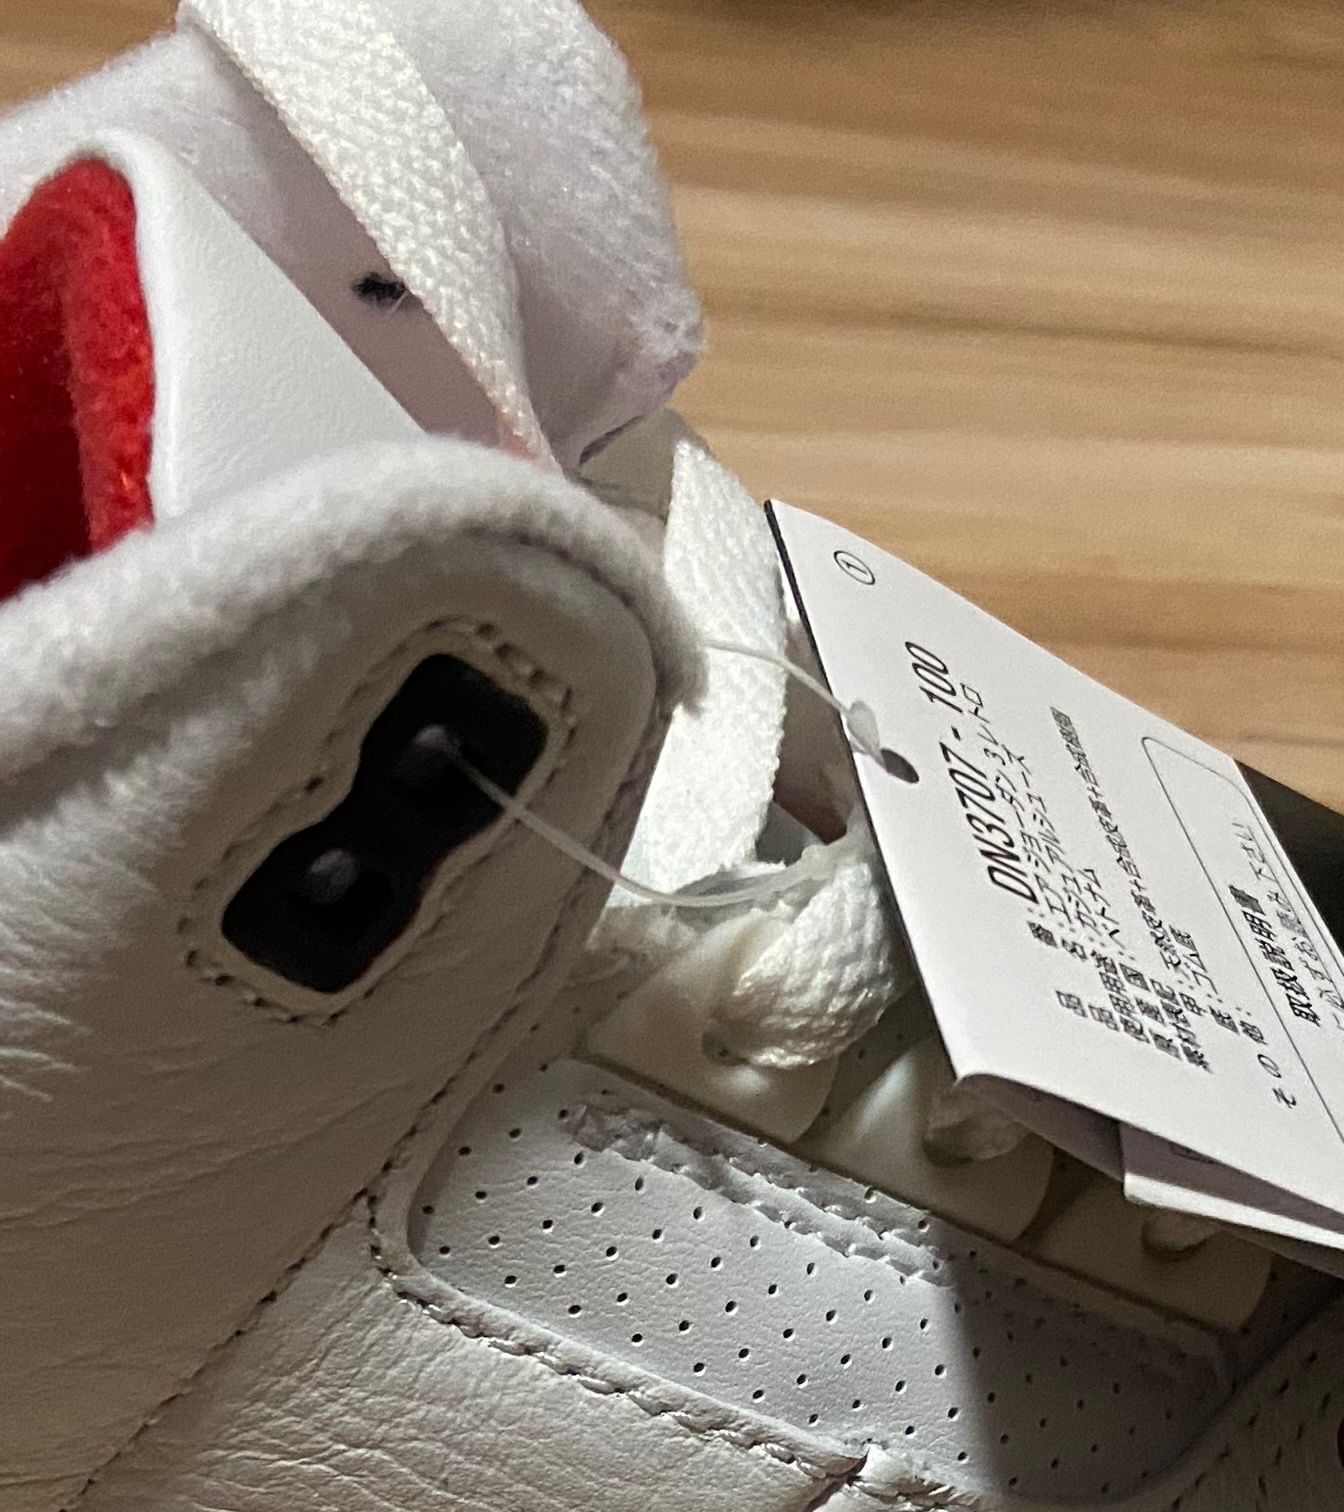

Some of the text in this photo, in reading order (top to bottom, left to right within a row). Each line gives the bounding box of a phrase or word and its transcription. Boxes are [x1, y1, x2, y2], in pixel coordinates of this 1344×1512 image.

[905, 641, 964, 714] 100
[951, 725, 962, 741] -
[983, 748, 1006, 766] 3
[939, 741, 1040, 905] DN3707
[1228, 884, 1321, 1027] 取扱説明書
